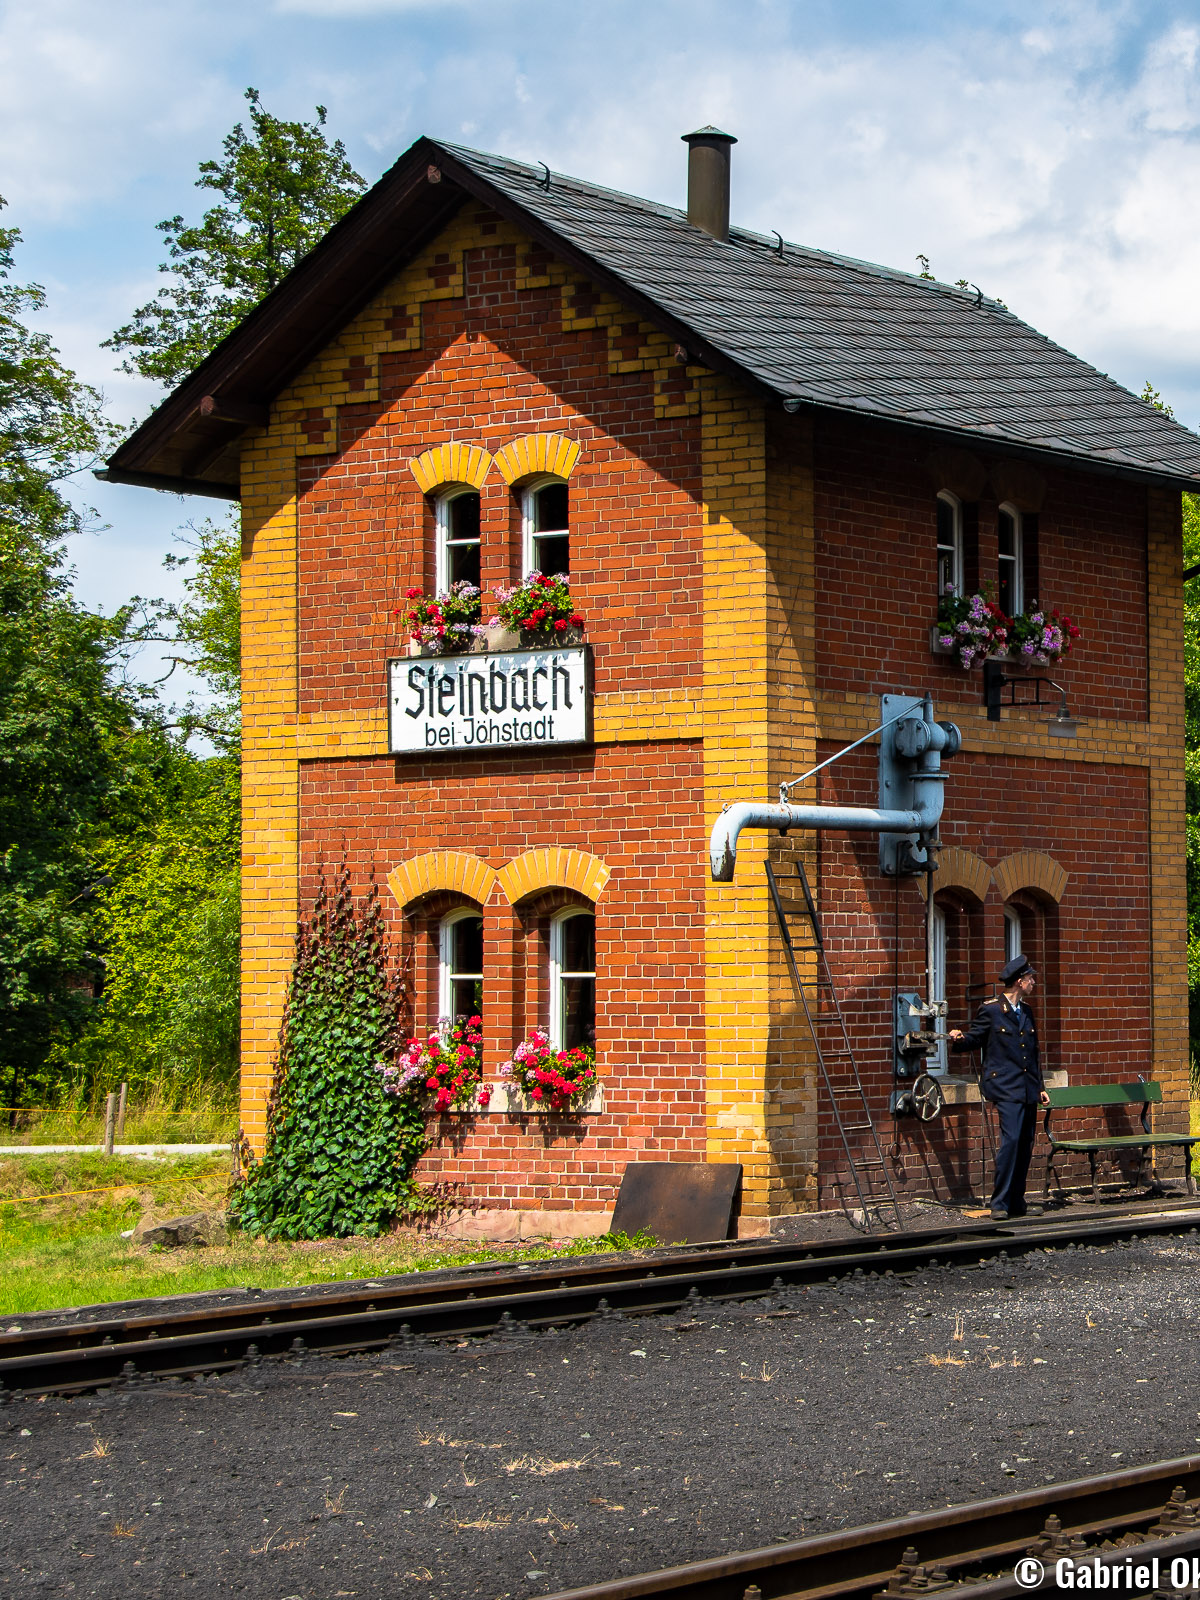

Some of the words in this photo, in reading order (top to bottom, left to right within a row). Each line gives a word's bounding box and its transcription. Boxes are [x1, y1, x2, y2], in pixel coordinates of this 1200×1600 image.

[405, 655, 573, 720] Steinbach
[425, 722, 456, 747] bei
[463, 715, 555, 745] Jöhstadt
